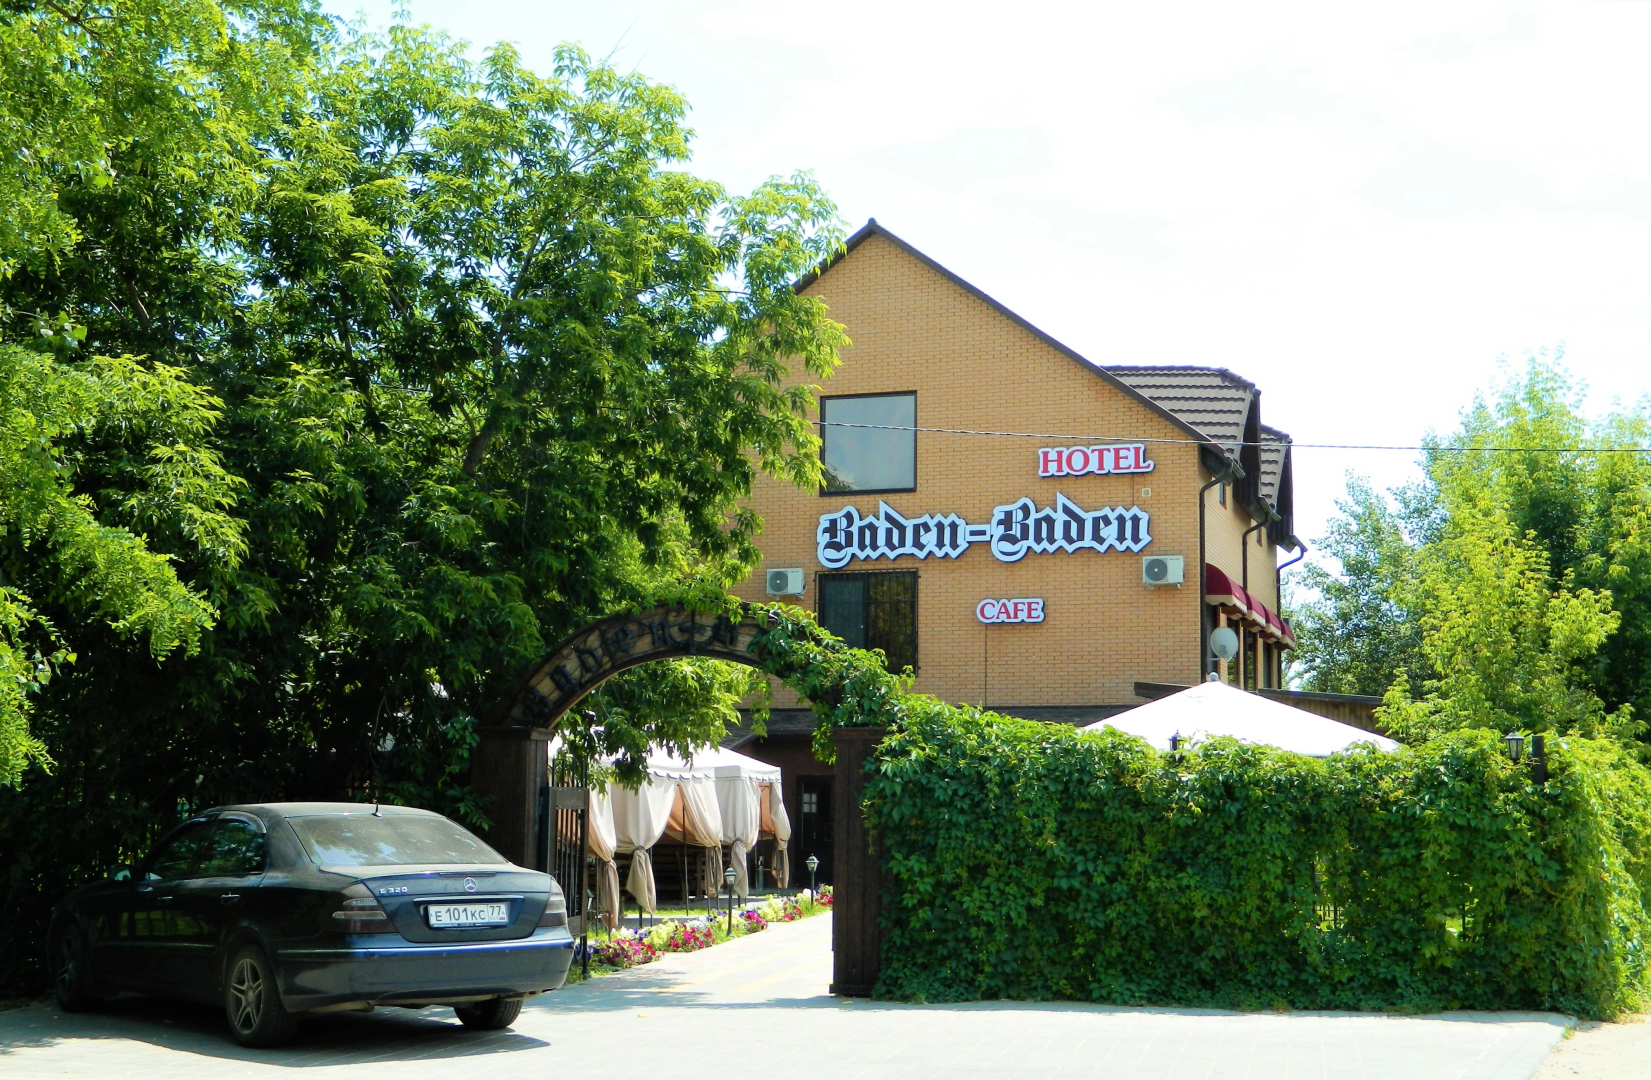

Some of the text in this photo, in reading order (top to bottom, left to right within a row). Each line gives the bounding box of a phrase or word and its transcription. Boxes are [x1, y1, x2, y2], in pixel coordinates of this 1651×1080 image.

[1040, 447, 1151, 474] HOTEL
[821, 500, 1150, 562] Baden-Baden
[979, 601, 1041, 620] CAFE
[489, 905, 502, 916] 77
